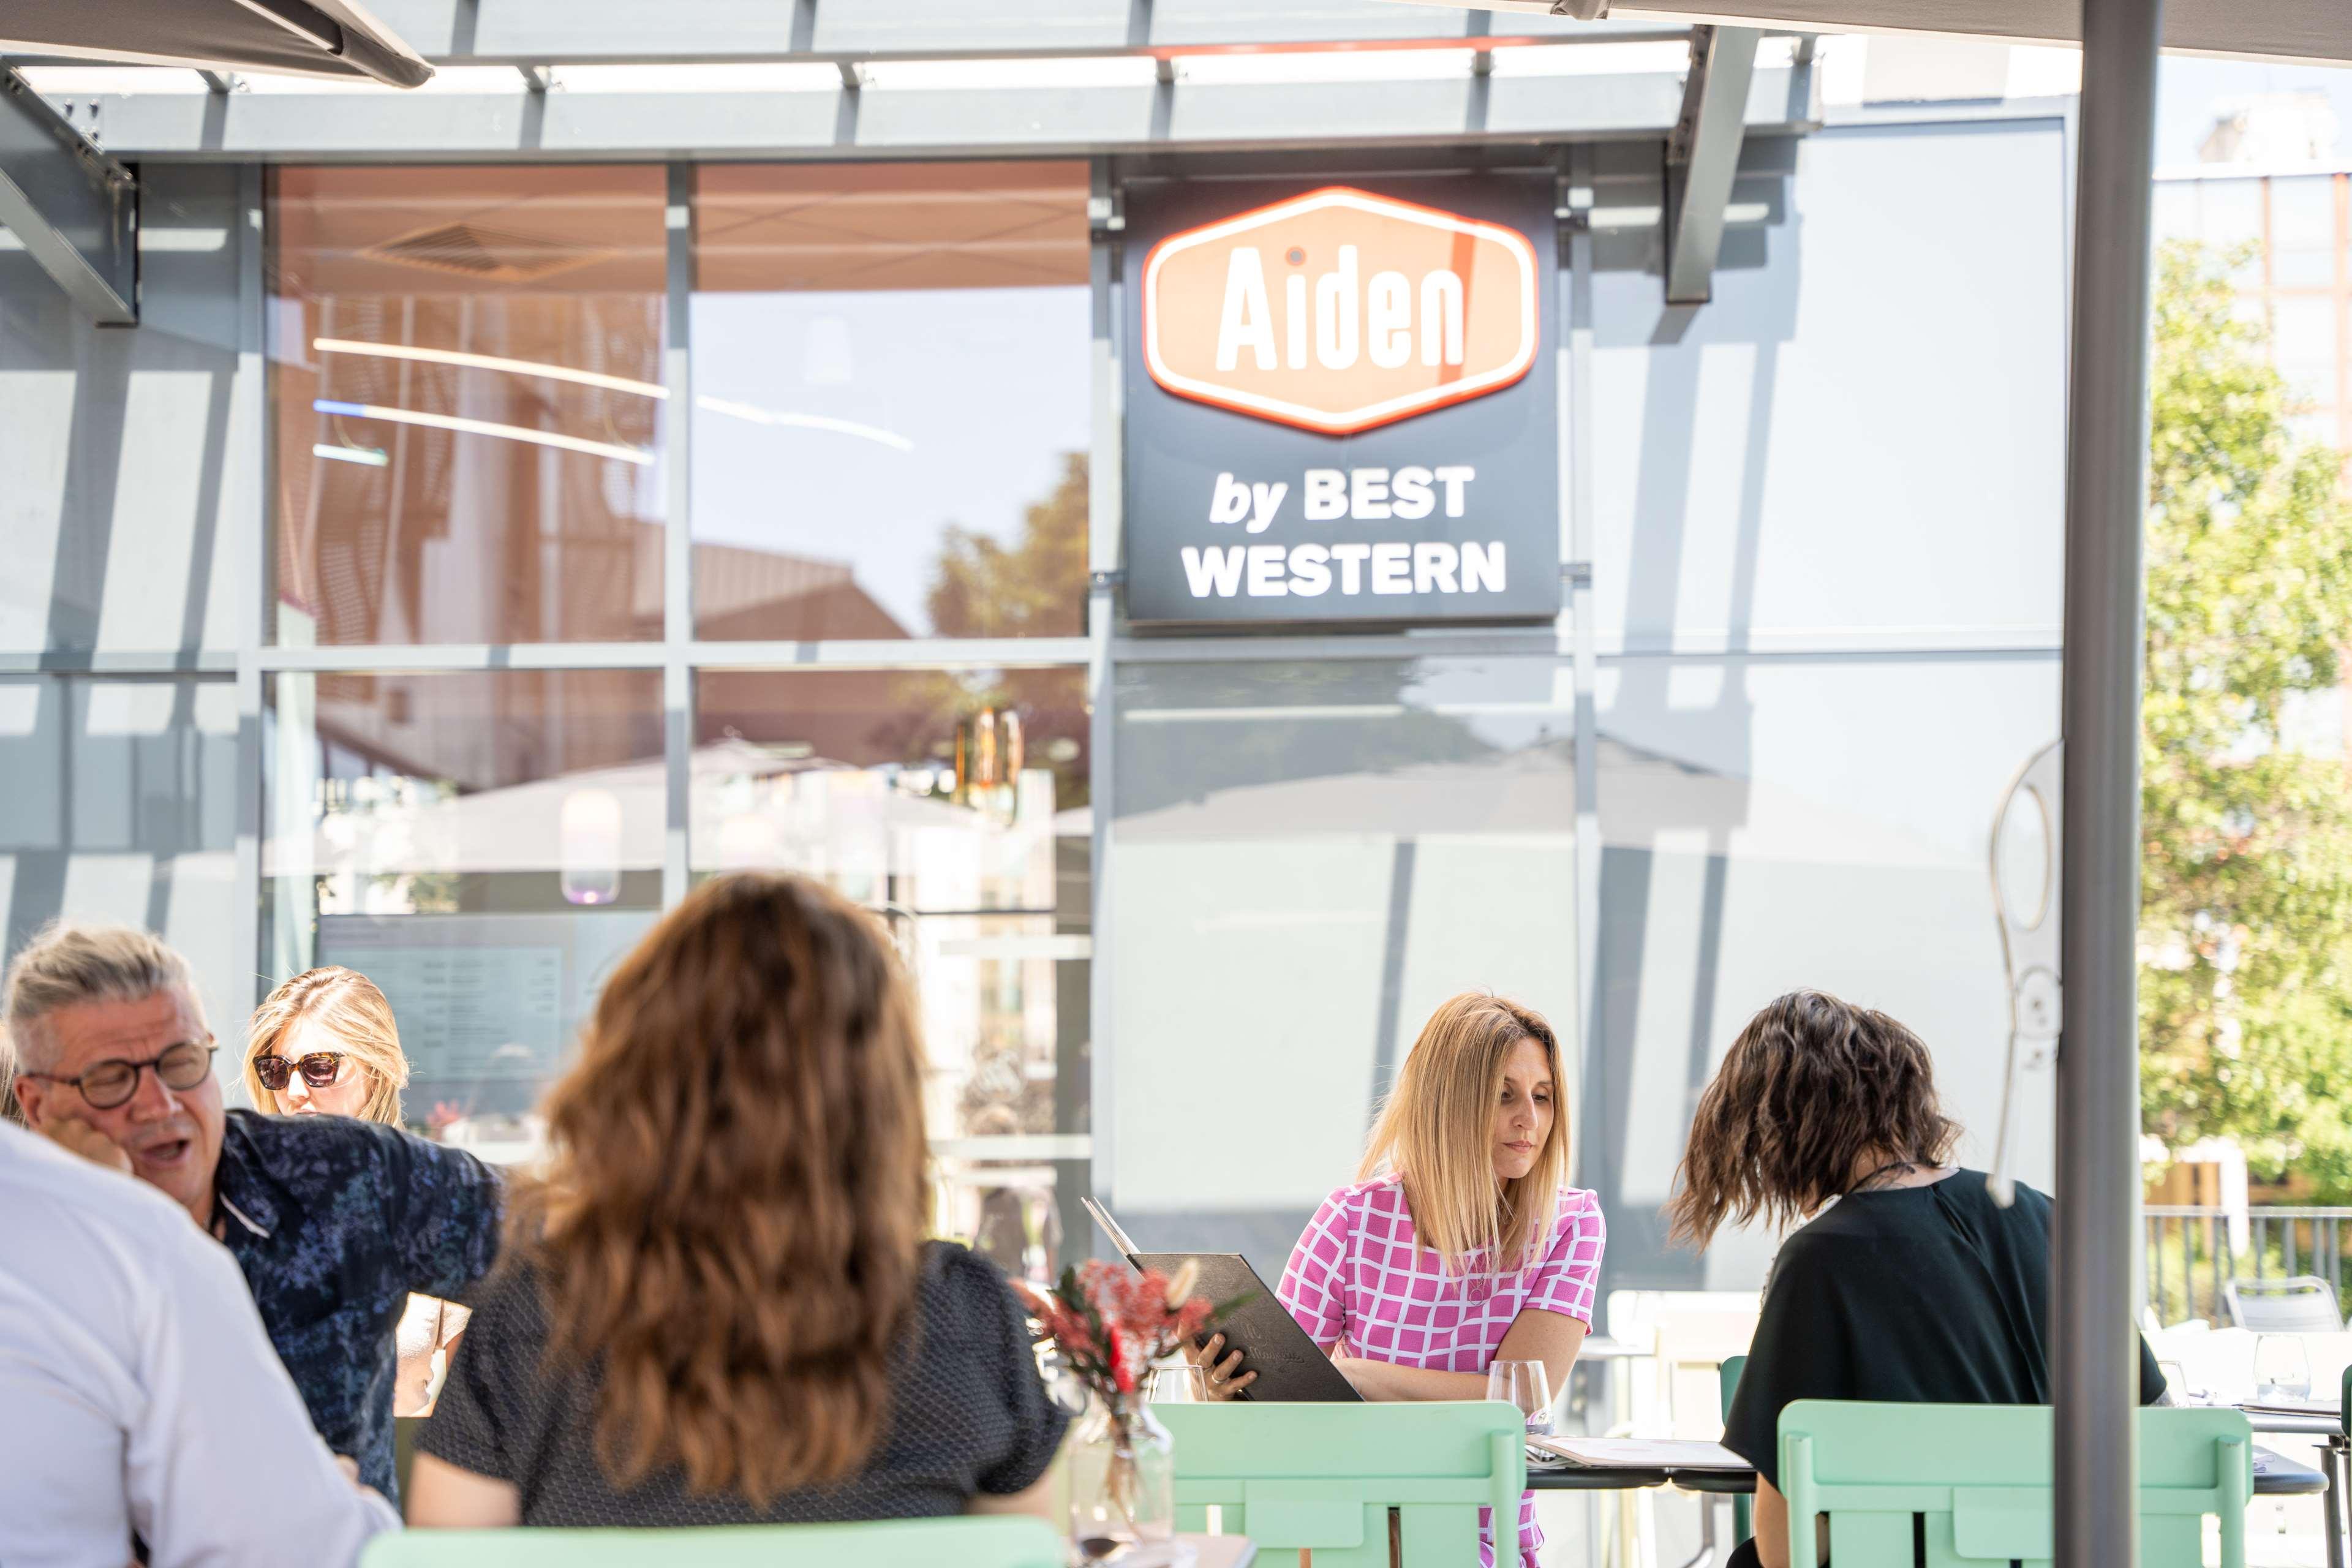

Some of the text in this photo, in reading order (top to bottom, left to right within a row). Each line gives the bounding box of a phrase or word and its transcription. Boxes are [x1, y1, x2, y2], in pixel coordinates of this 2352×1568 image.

[1216, 244, 1464, 371] Aiden
[1209, 466, 1476, 533] by BEST
[1181, 541, 1506, 598] WESTERN
